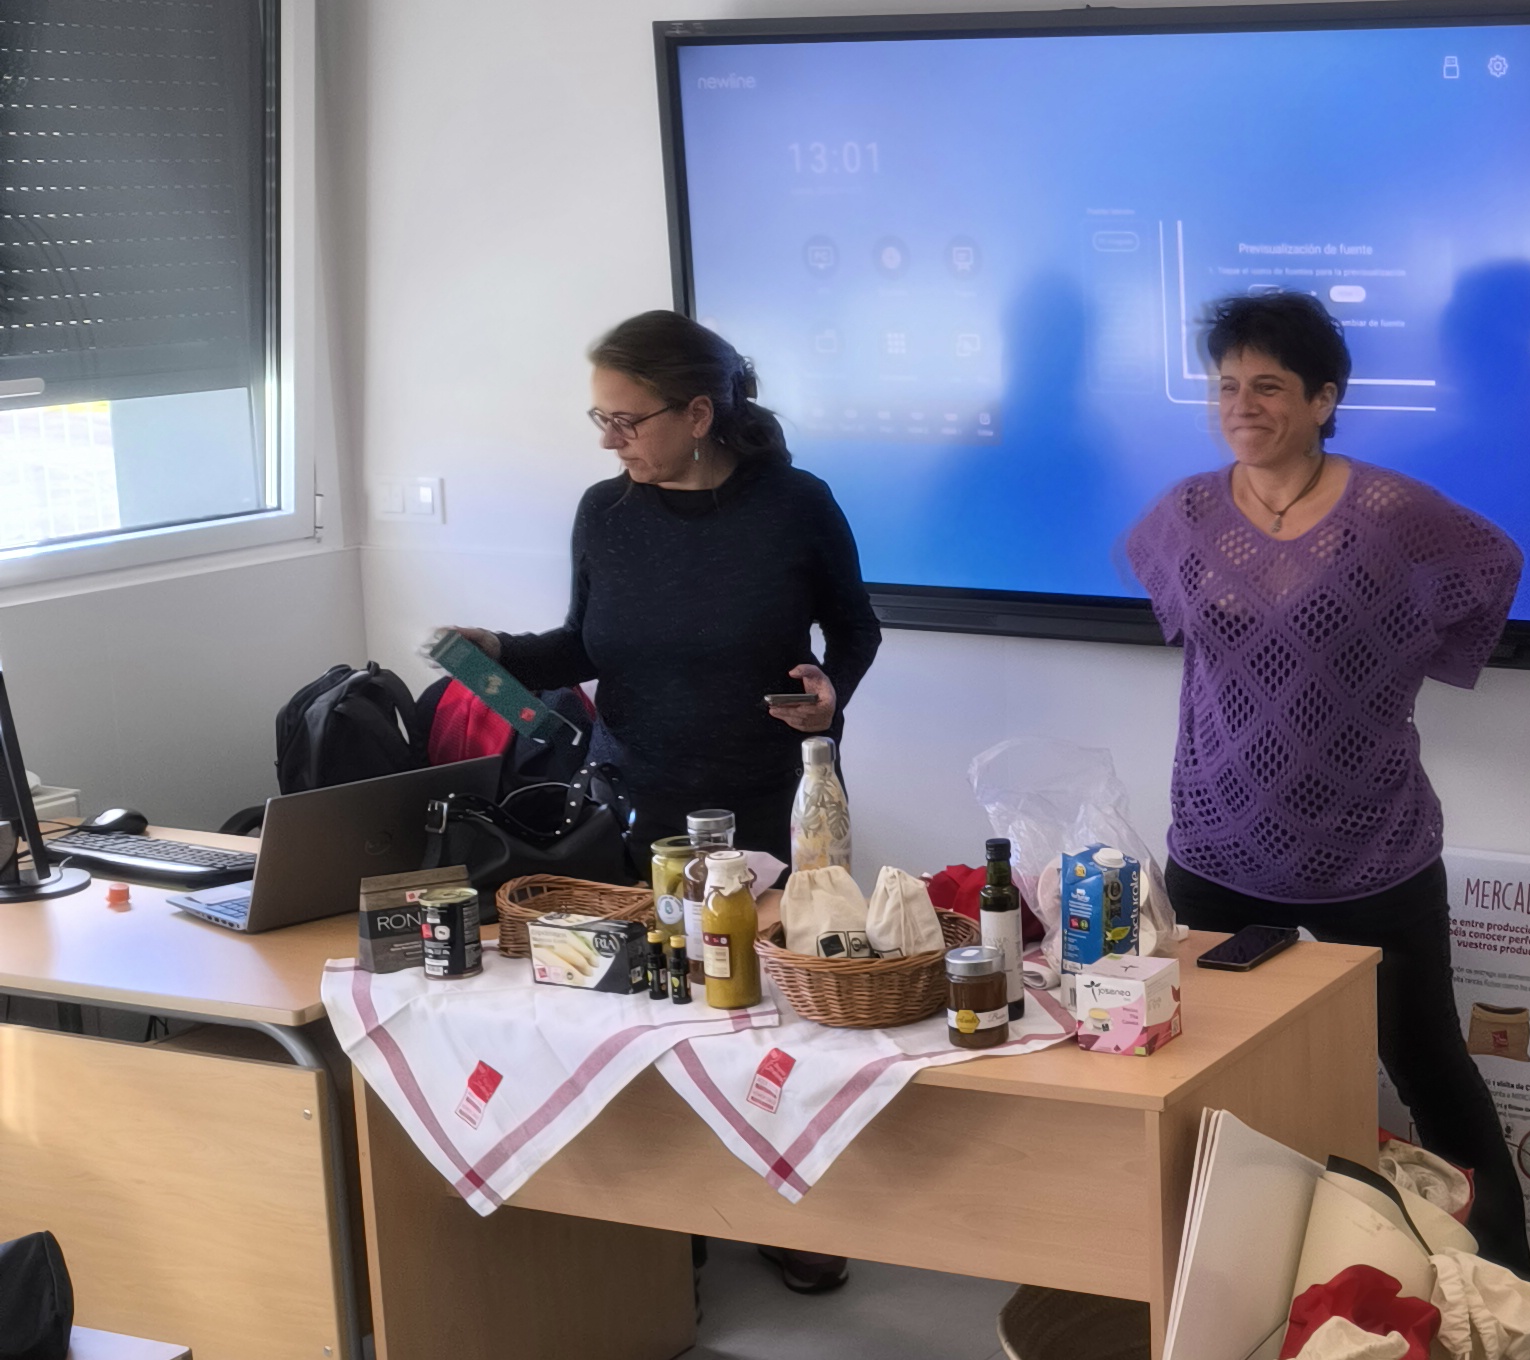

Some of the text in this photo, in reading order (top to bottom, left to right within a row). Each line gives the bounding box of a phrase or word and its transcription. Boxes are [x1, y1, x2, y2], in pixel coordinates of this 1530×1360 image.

[698, 73, 756, 89] newline
[788, 142, 880, 174] 13:01
[1238, 243, 1373, 256] Previsualización de fuente
[1338, 318, 1367, 327] ambiar
[1459, 920, 1485, 929] entre
[1469, 931, 1506, 942] conocer
[1457, 940, 1498, 951] vuestros
